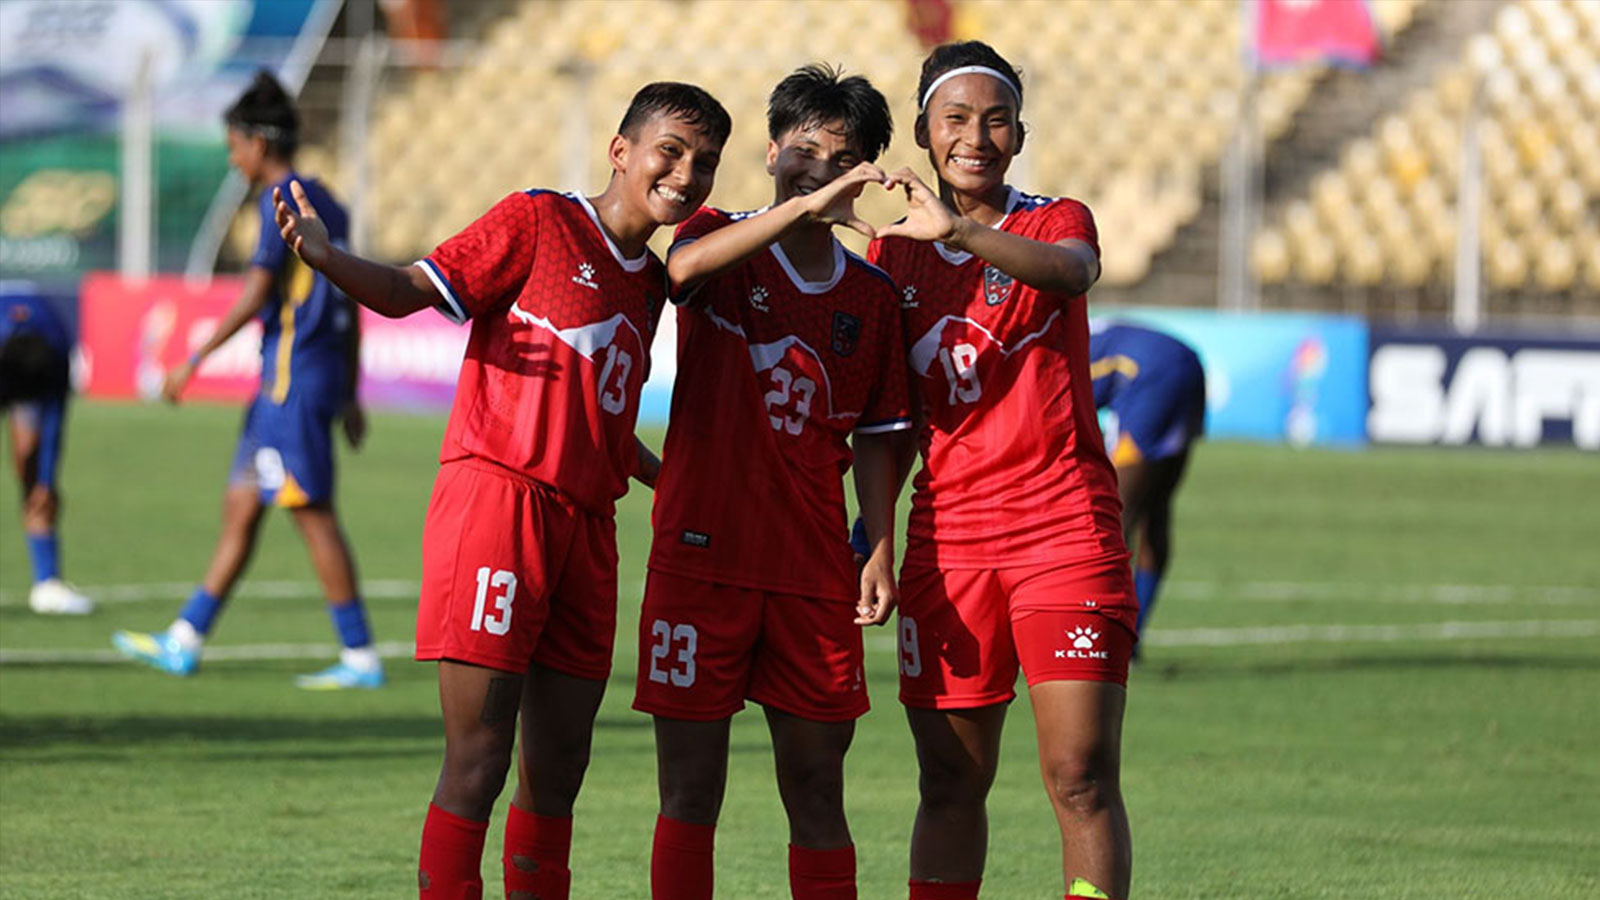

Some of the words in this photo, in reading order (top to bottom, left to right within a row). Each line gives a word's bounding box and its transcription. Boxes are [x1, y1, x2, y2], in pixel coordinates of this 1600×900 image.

[598, 344, 632, 415] 13
[764, 366, 816, 434] 23
[938, 343, 983, 405] 19
[470, 566, 517, 635] 13
[649, 619, 698, 687] 23
[1054, 650, 1109, 660] KELME
